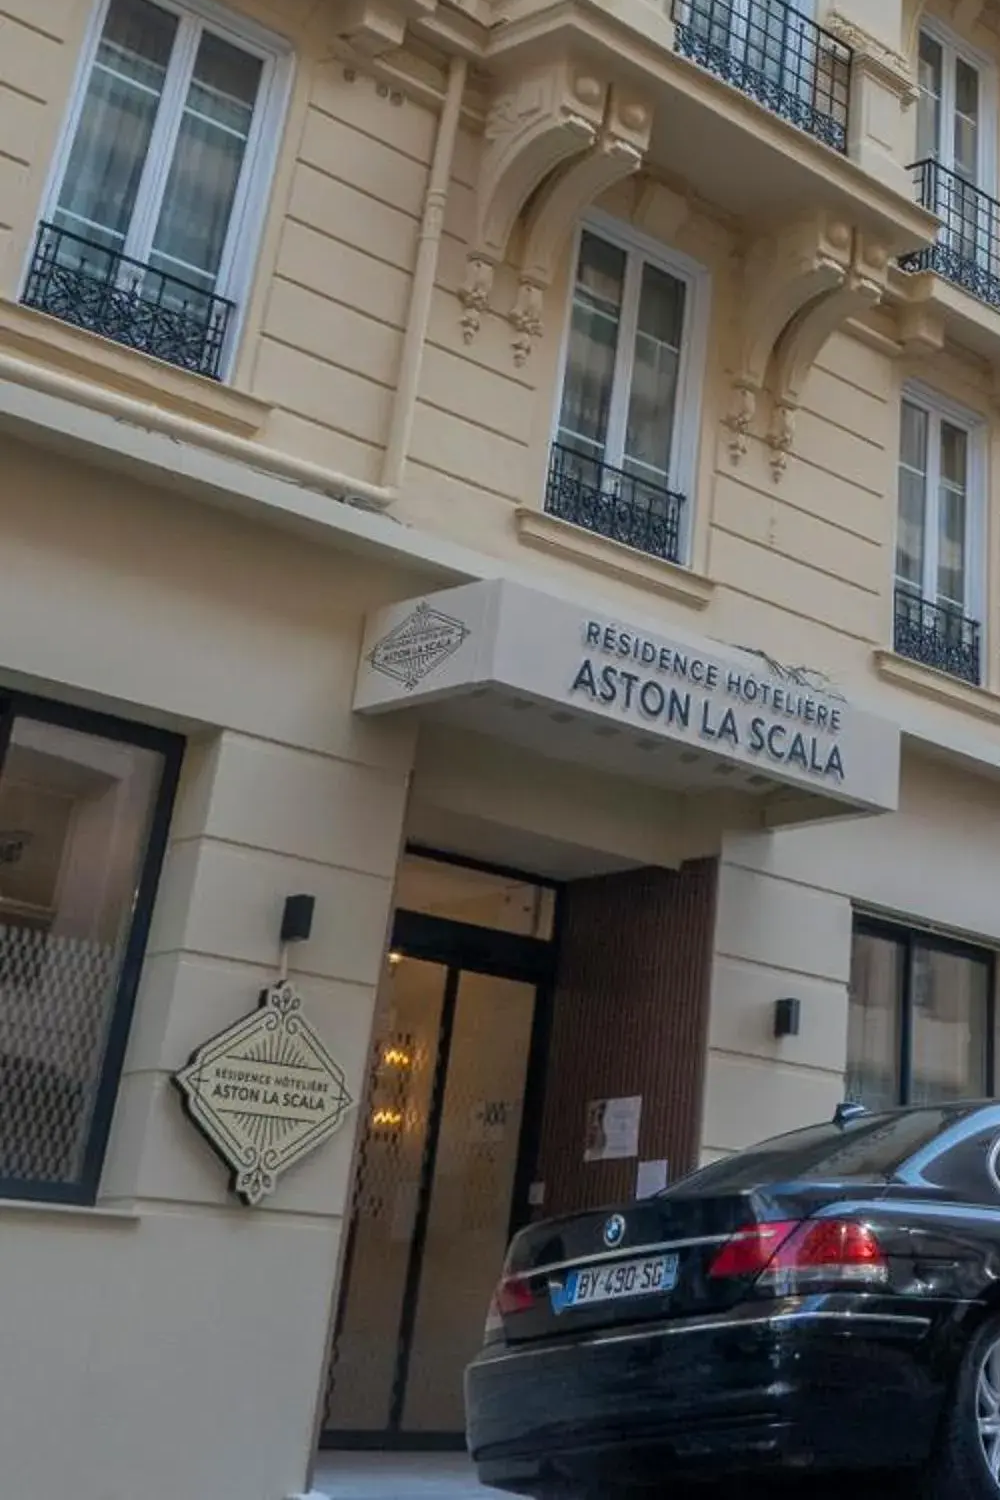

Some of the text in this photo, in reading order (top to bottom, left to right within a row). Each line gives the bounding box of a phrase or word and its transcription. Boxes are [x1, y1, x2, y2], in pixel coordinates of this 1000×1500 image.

[572, 659, 844, 779] ASTON LA SCALA
[212, 1084, 325, 1111] ASTON LA SCALA
